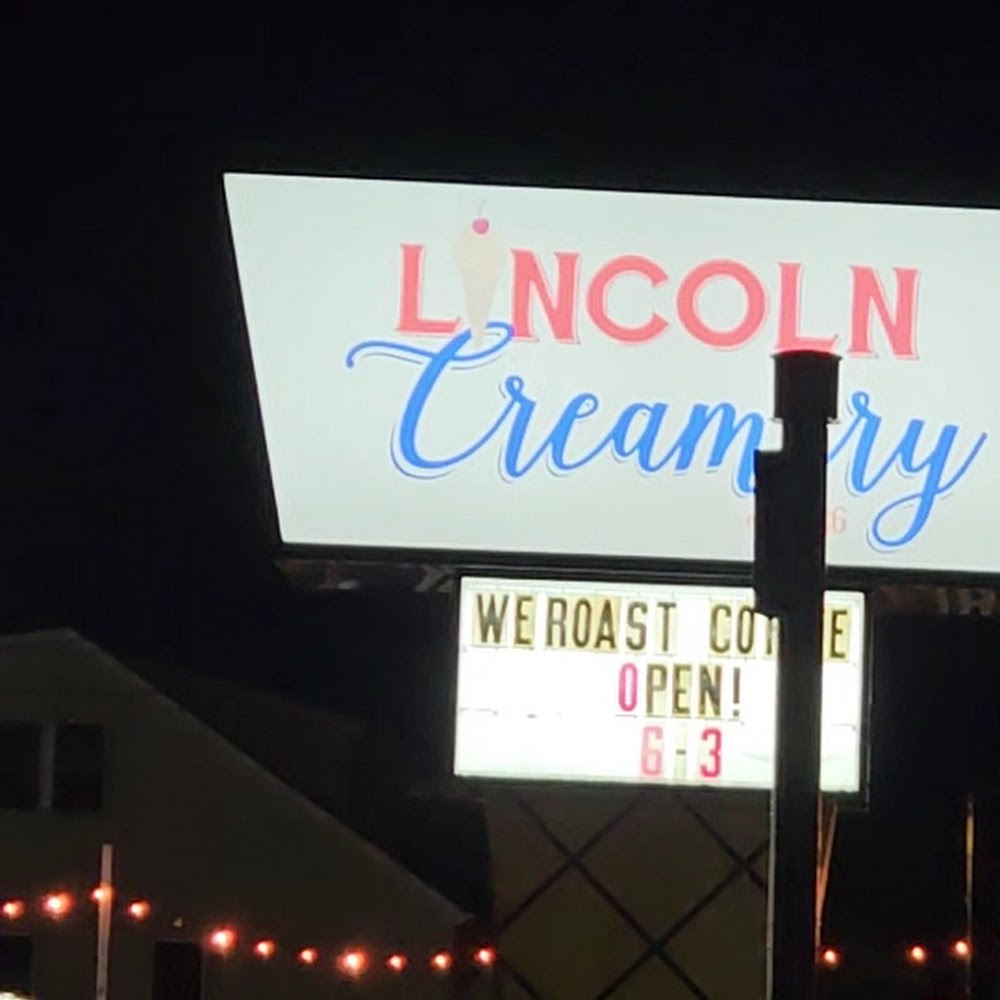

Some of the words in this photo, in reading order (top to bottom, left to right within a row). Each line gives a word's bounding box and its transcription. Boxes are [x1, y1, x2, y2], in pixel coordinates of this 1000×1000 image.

[394, 240, 920, 362] LINCOLN
[346, 320, 988, 552] Creamry
[618, 661, 741, 718] OPEN!
